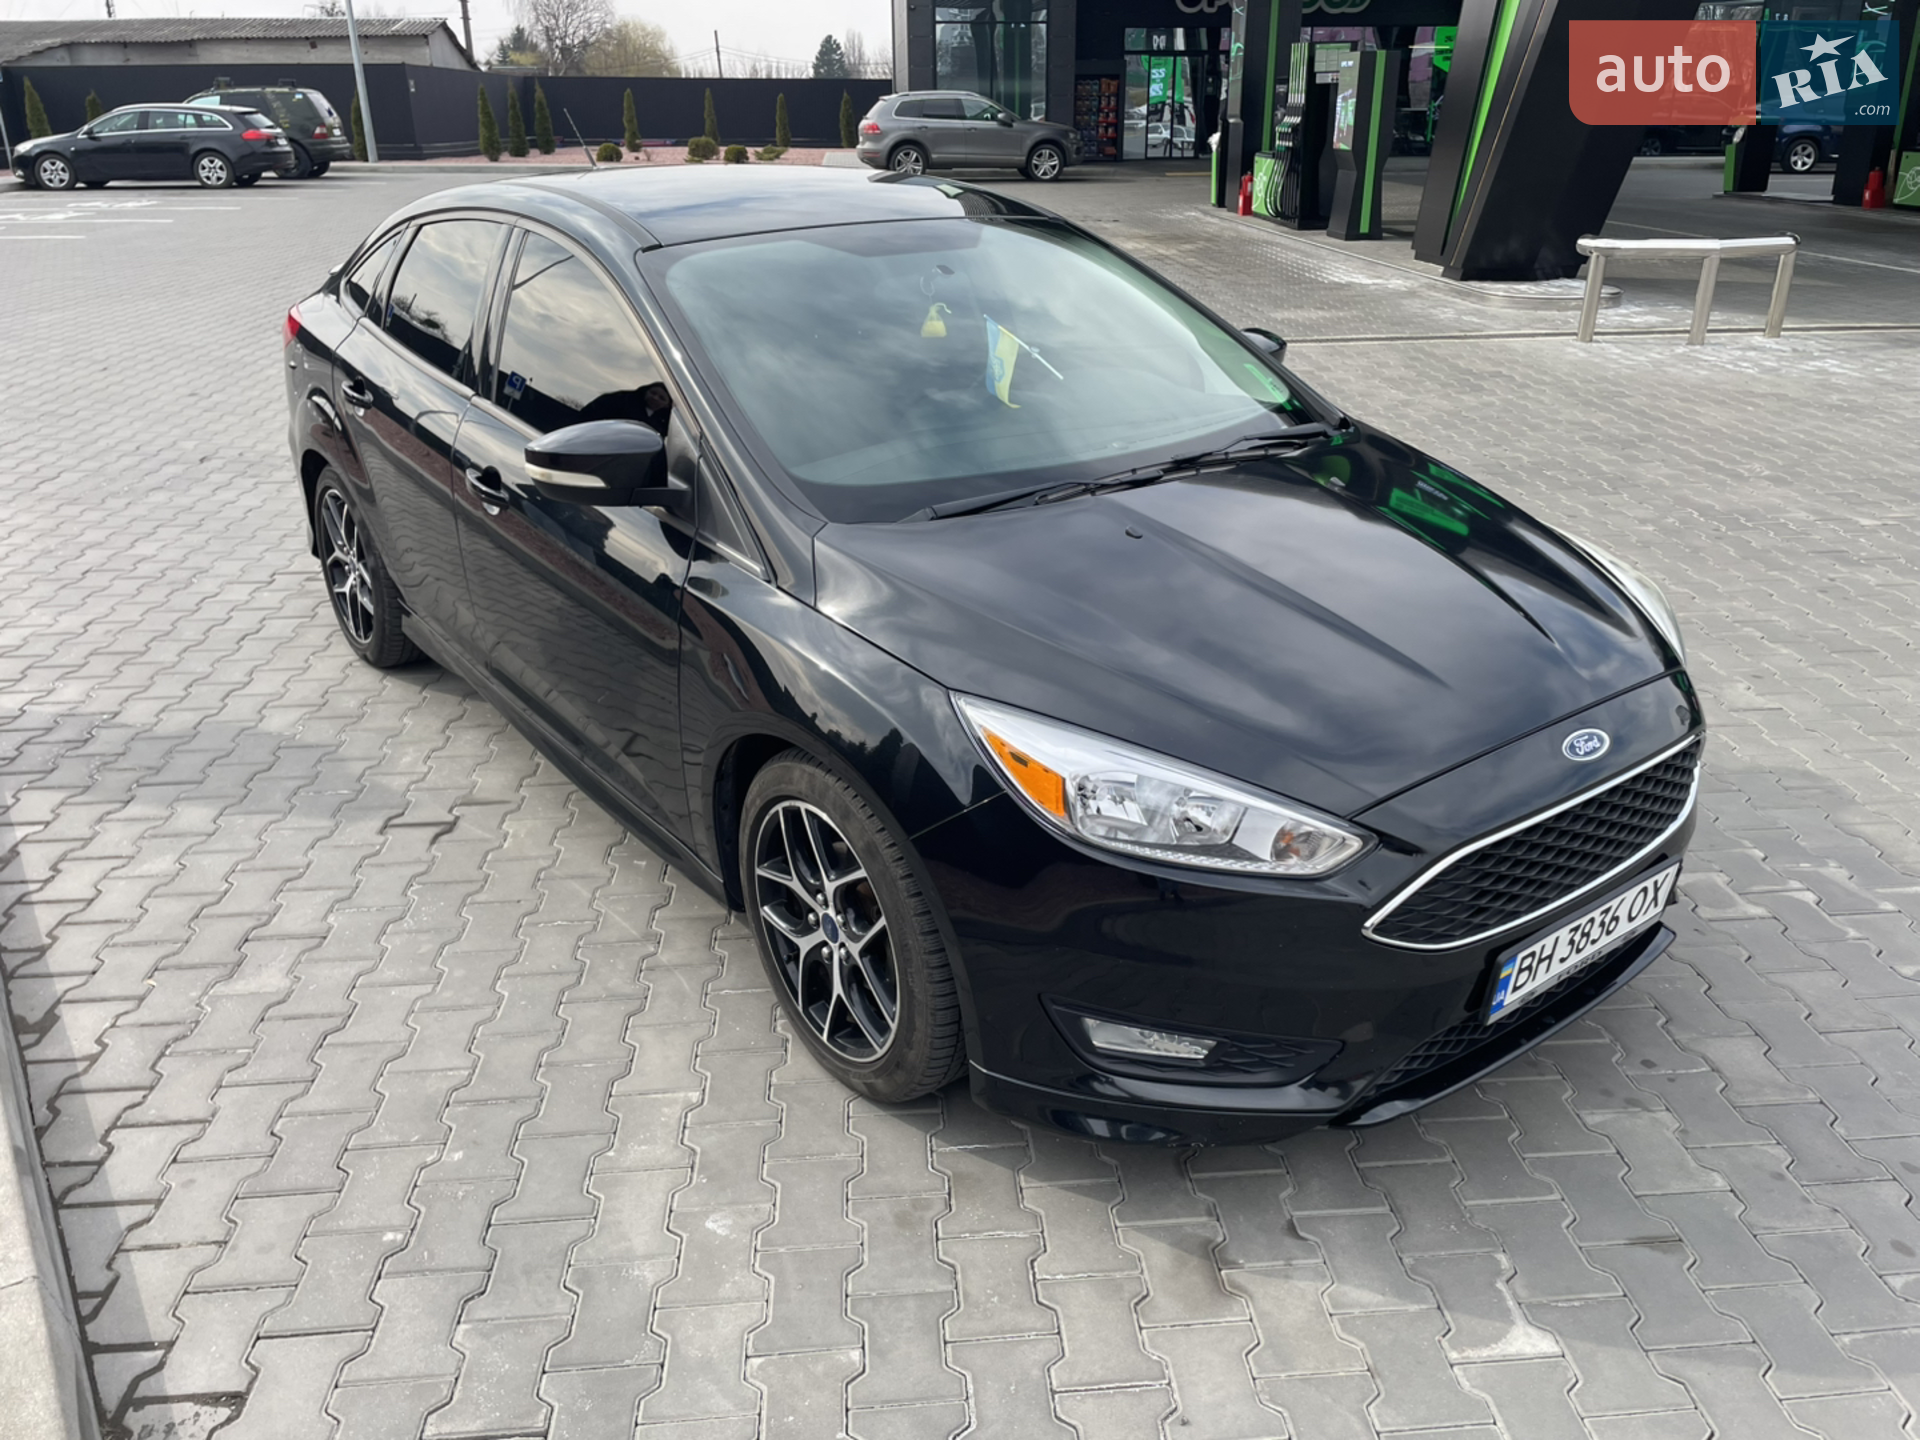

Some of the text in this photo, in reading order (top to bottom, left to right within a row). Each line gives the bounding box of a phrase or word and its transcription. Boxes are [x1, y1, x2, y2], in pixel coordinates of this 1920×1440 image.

[1573, 735, 1601, 755] Ford
[1511, 872, 1670, 994] BH 3836 OX
[1492, 990, 1506, 1005] UA
